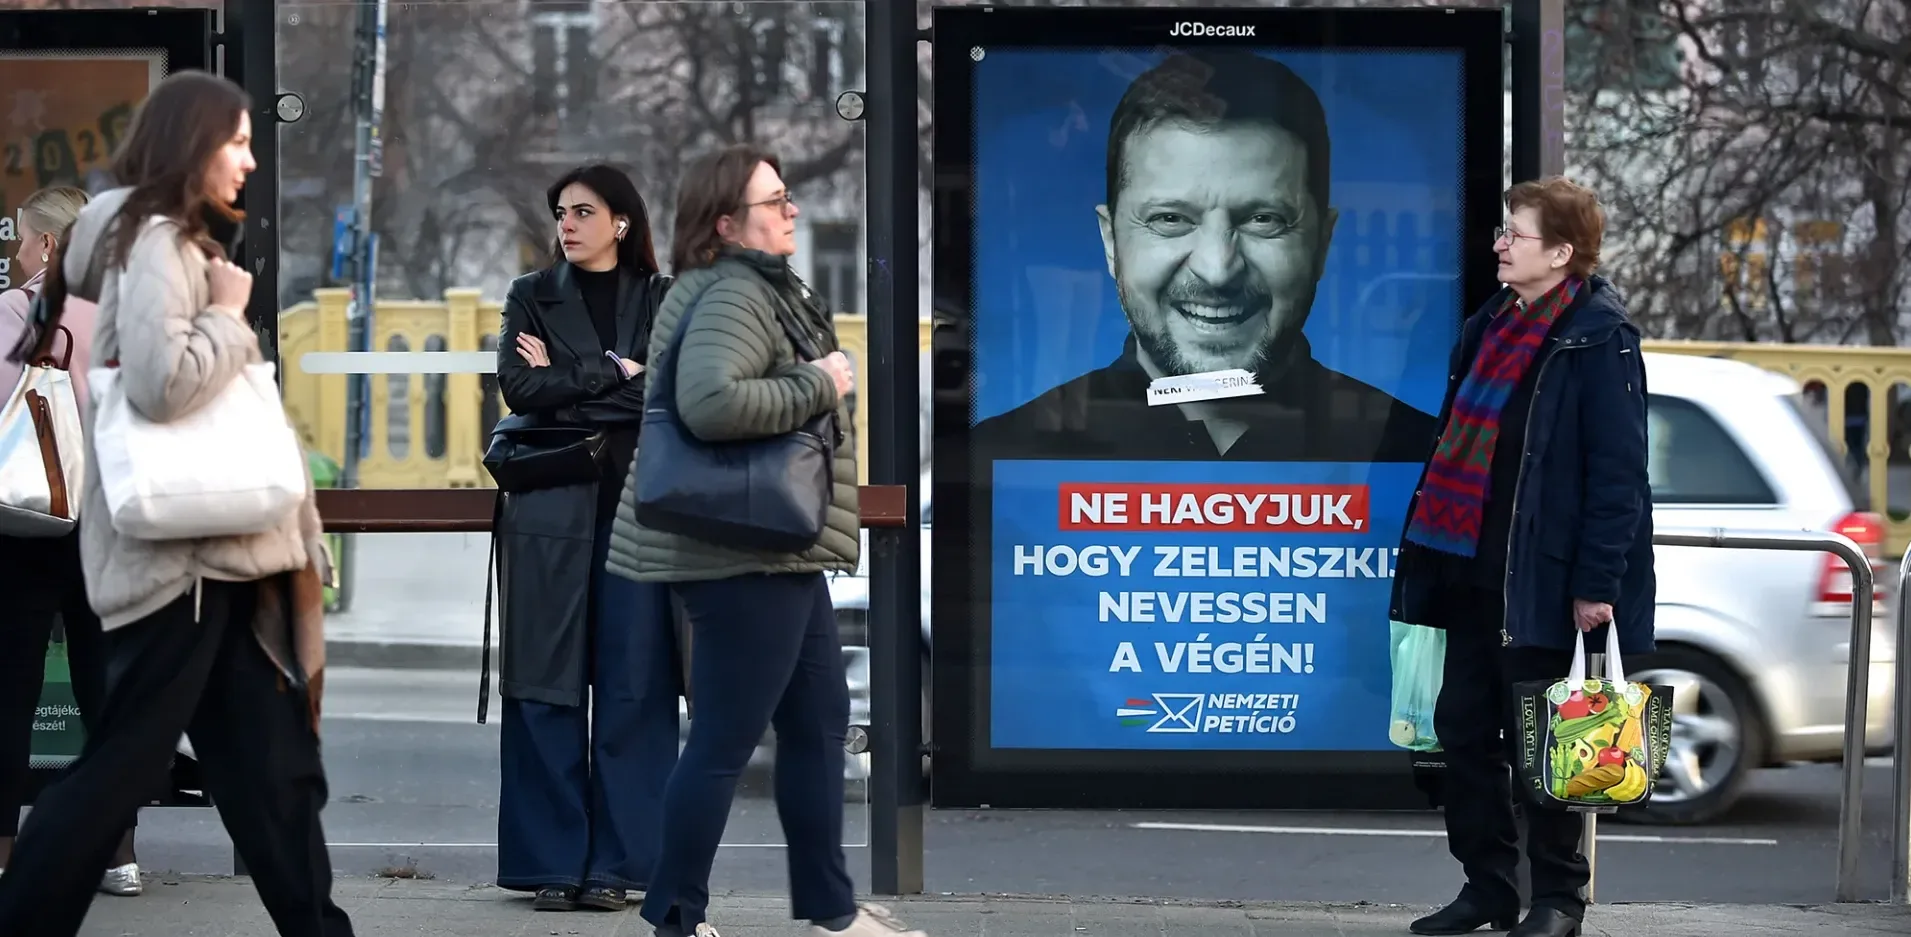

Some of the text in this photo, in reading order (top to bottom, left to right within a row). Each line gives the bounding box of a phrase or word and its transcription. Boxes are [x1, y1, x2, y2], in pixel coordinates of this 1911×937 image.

[1169, 21, 1256, 36] JCDecaux
[1070, 493, 1363, 530] NE HAGYJUK,
[1013, 545, 1141, 577] HOGY
[1099, 591, 1326, 623] NEVESSEN
[1108, 633, 1314, 674] A VÉGÉN!
[1207, 693, 1300, 709] NEMZETI
[1650, 696, 1660, 724] GAME
[1203, 711, 1297, 733] PETÍCIÓ
[1524, 703, 1534, 729] LOVE
[1662, 707, 1672, 732] YEAR
[1525, 730, 1535, 747] MY
